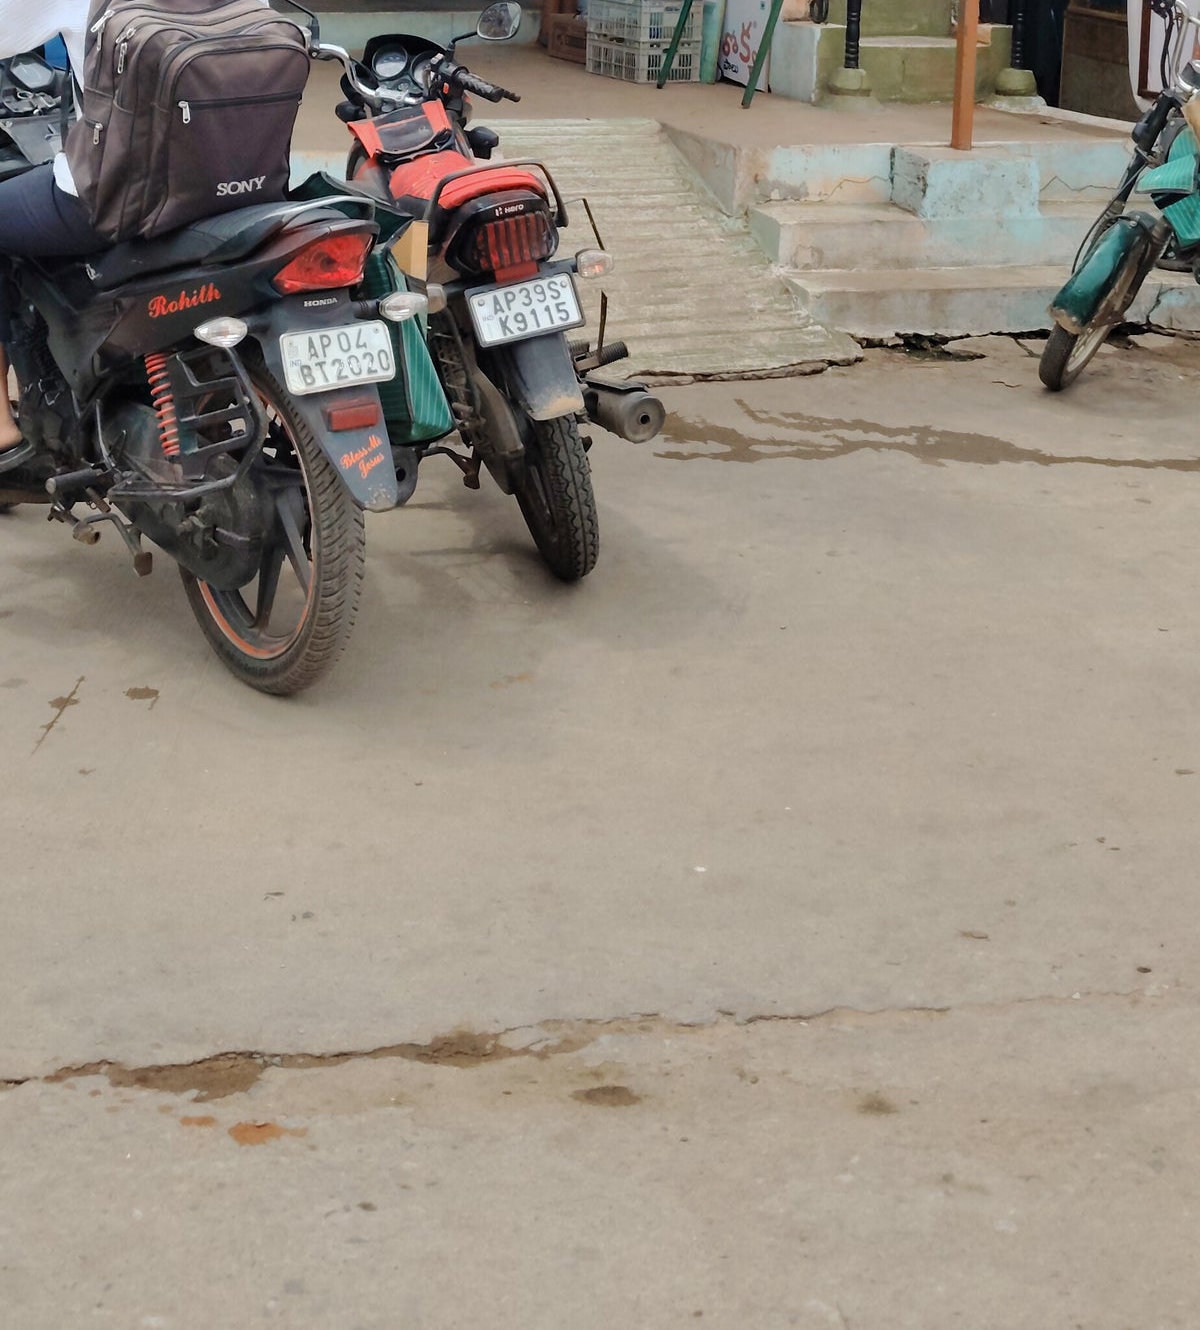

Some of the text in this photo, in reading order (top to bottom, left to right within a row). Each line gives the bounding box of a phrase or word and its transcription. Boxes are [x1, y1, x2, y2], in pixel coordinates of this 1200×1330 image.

[216, 175, 267, 197] SONY
[303, 297, 338, 308] HONDA
[492, 280, 561, 315] AP39S
[498, 301, 570, 336] K9115
[299, 348, 391, 387] BT2020
